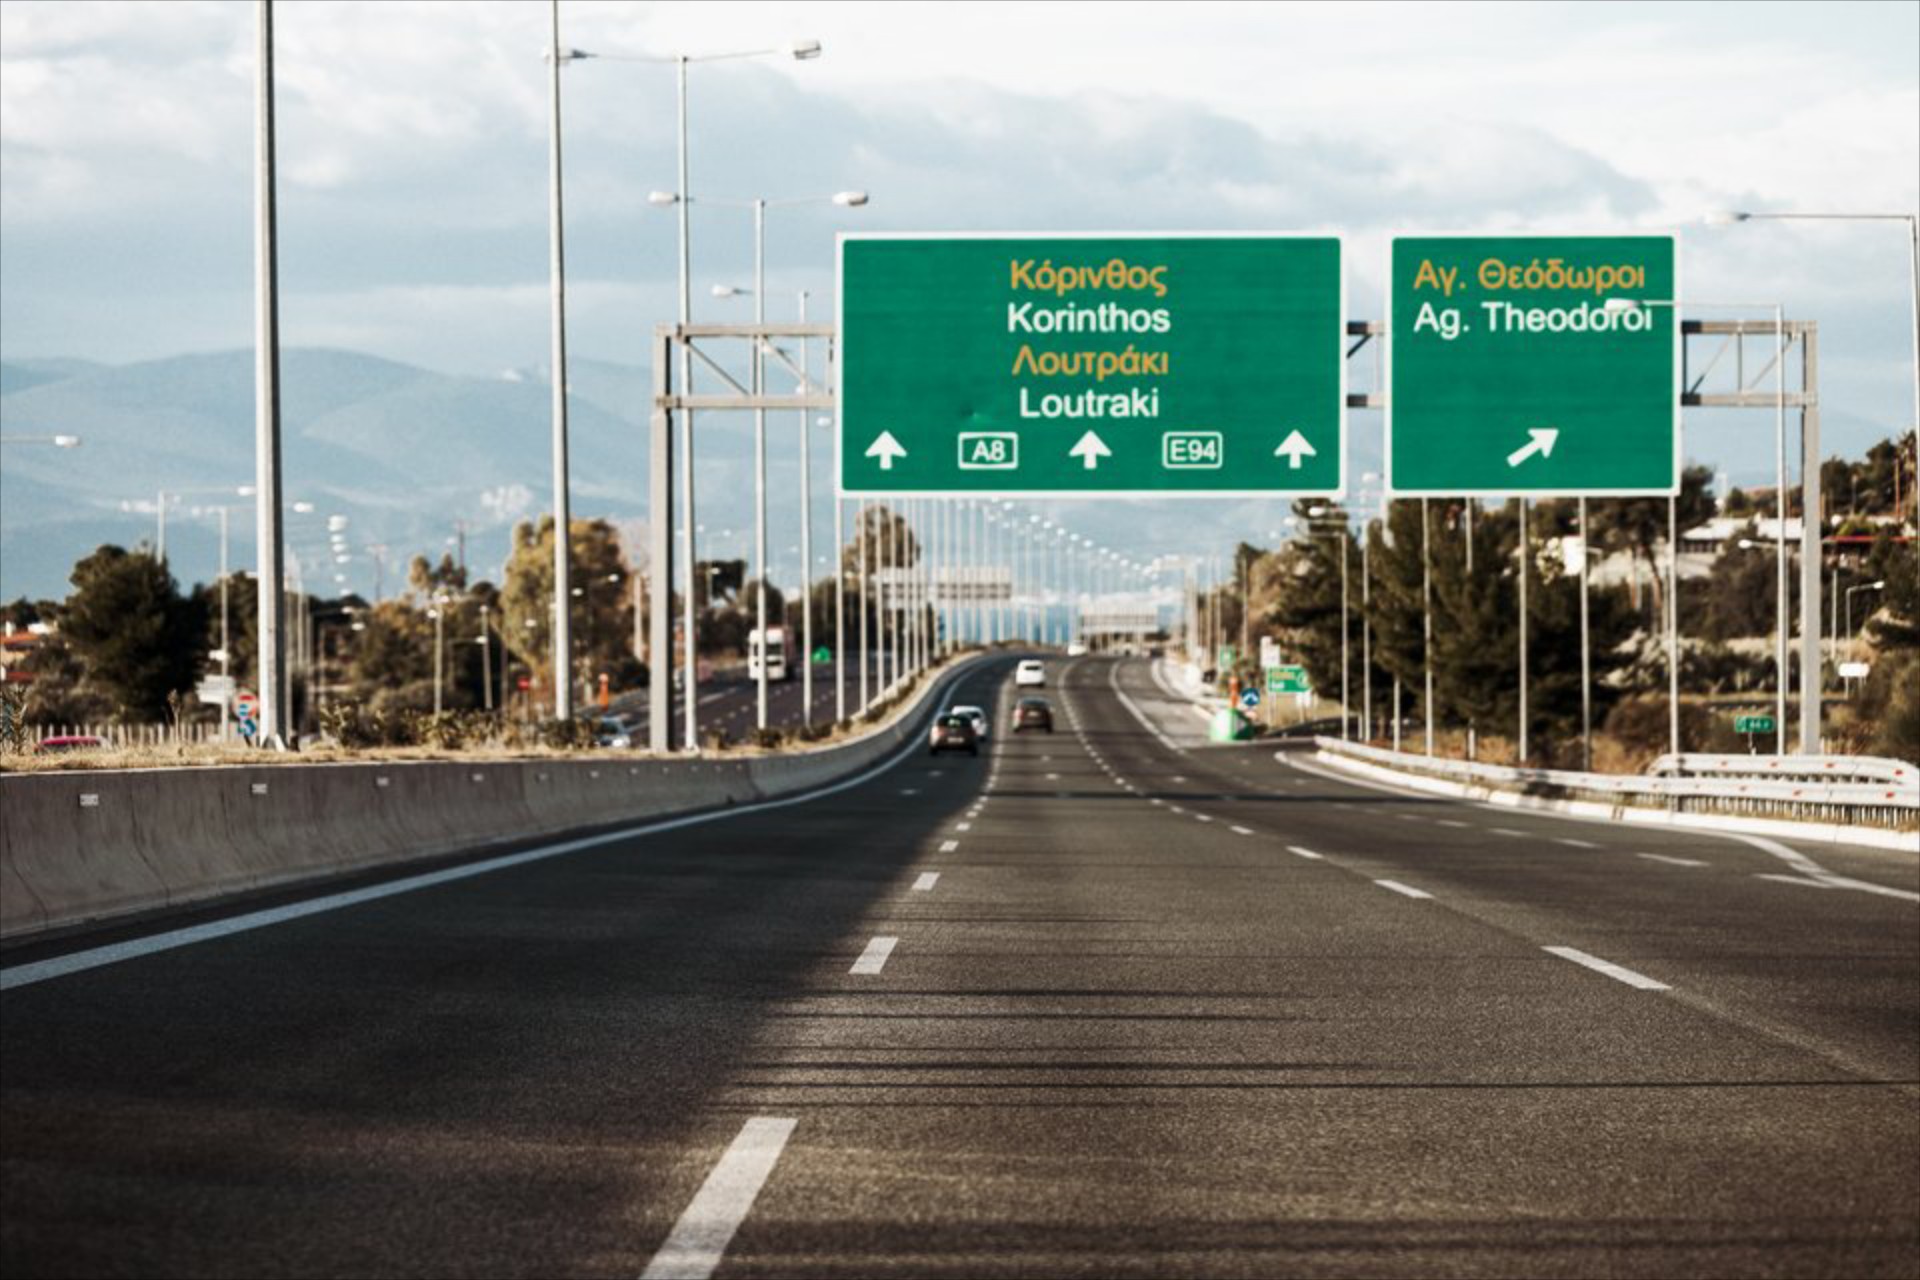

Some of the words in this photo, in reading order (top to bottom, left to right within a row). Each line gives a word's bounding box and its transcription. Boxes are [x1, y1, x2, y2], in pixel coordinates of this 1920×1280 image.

[1011, 259, 1168, 297] Κόρινθος
[1413, 259, 1466, 297] Αγ.
[1478, 258, 1645, 296] Θεόδωροι
[1008, 302, 1171, 333] Korinthos
[1413, 301, 1469, 340] Ag.
[1481, 301, 1652, 332] Theodoroi
[1012, 344, 1168, 381] Λουτράκι
[1020, 387, 1159, 418] Loutraki
[972, 439, 1005, 462] A8
[1170, 439, 1217, 462] E94
